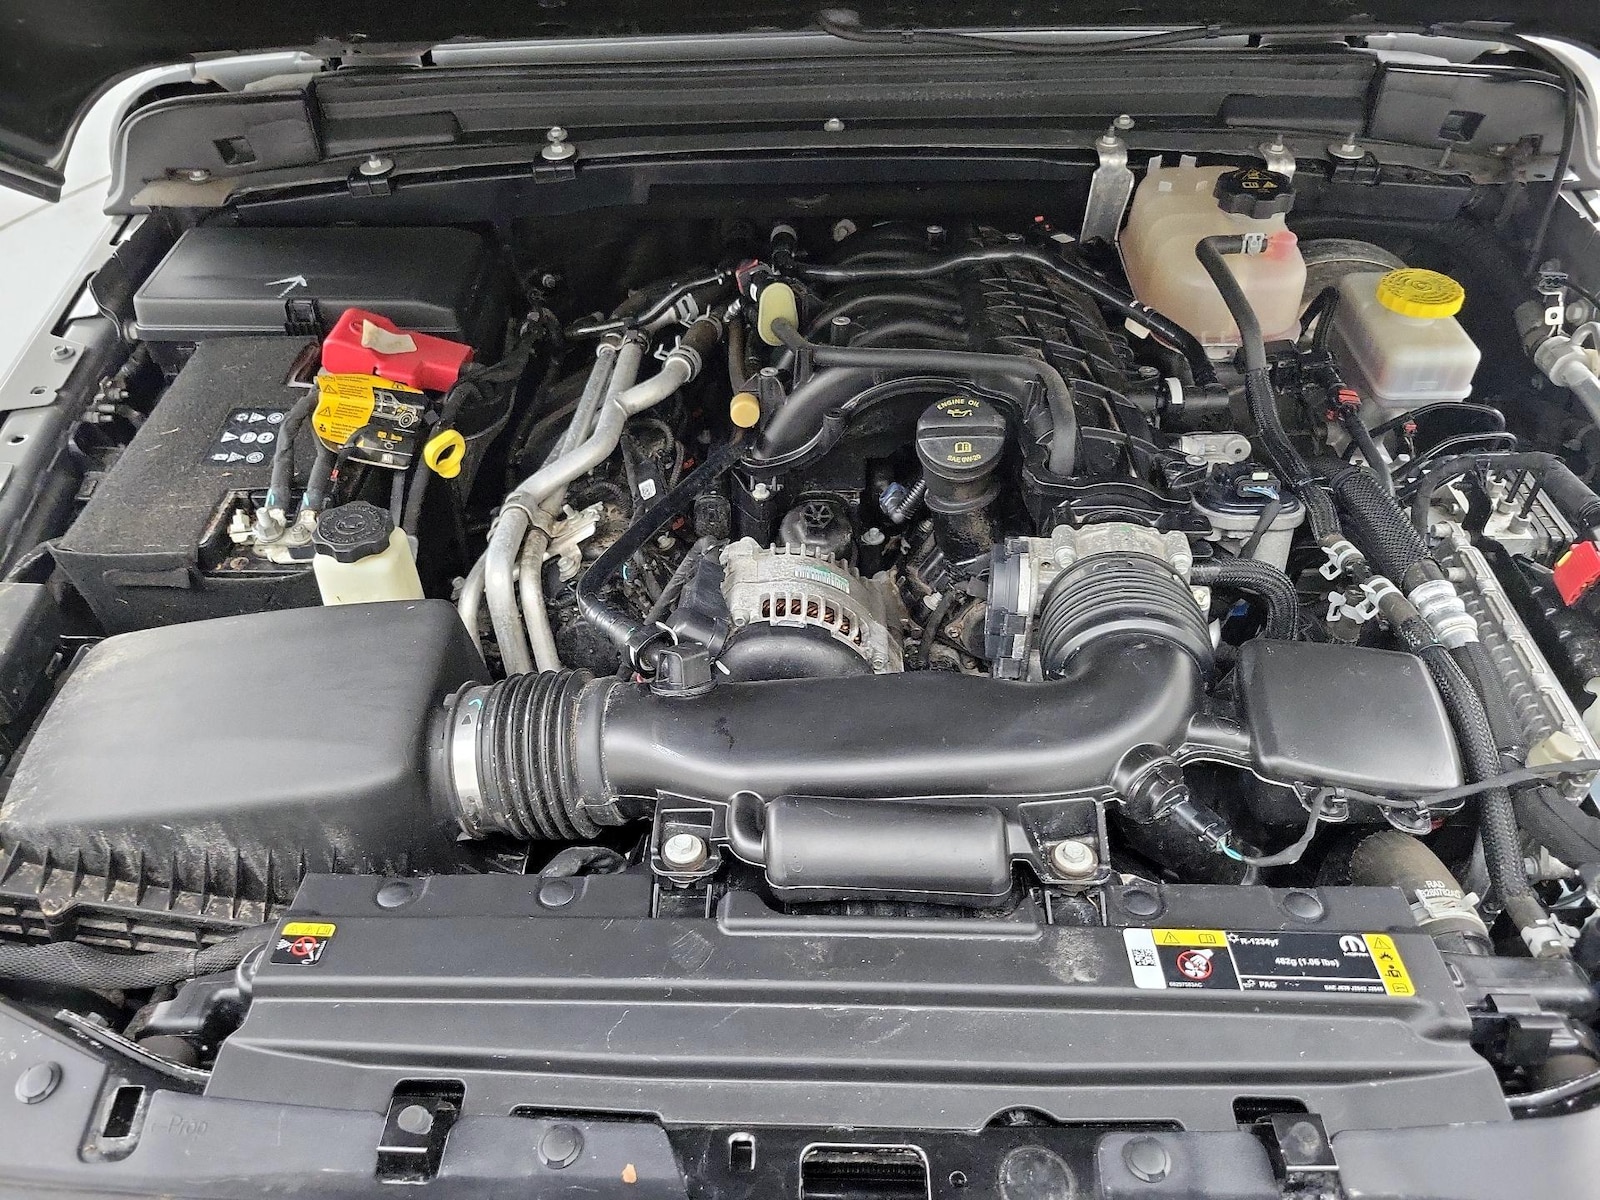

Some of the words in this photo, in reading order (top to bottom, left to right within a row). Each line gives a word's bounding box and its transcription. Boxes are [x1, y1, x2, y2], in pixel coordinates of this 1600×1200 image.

[937, 398, 965, 410] ENGINE
[968, 399, 980, 408] OIL
[946, 454, 961, 463] SAE
[1425, 880, 1445, 888] RAD
[1259, 981, 1278, 989] PAG
